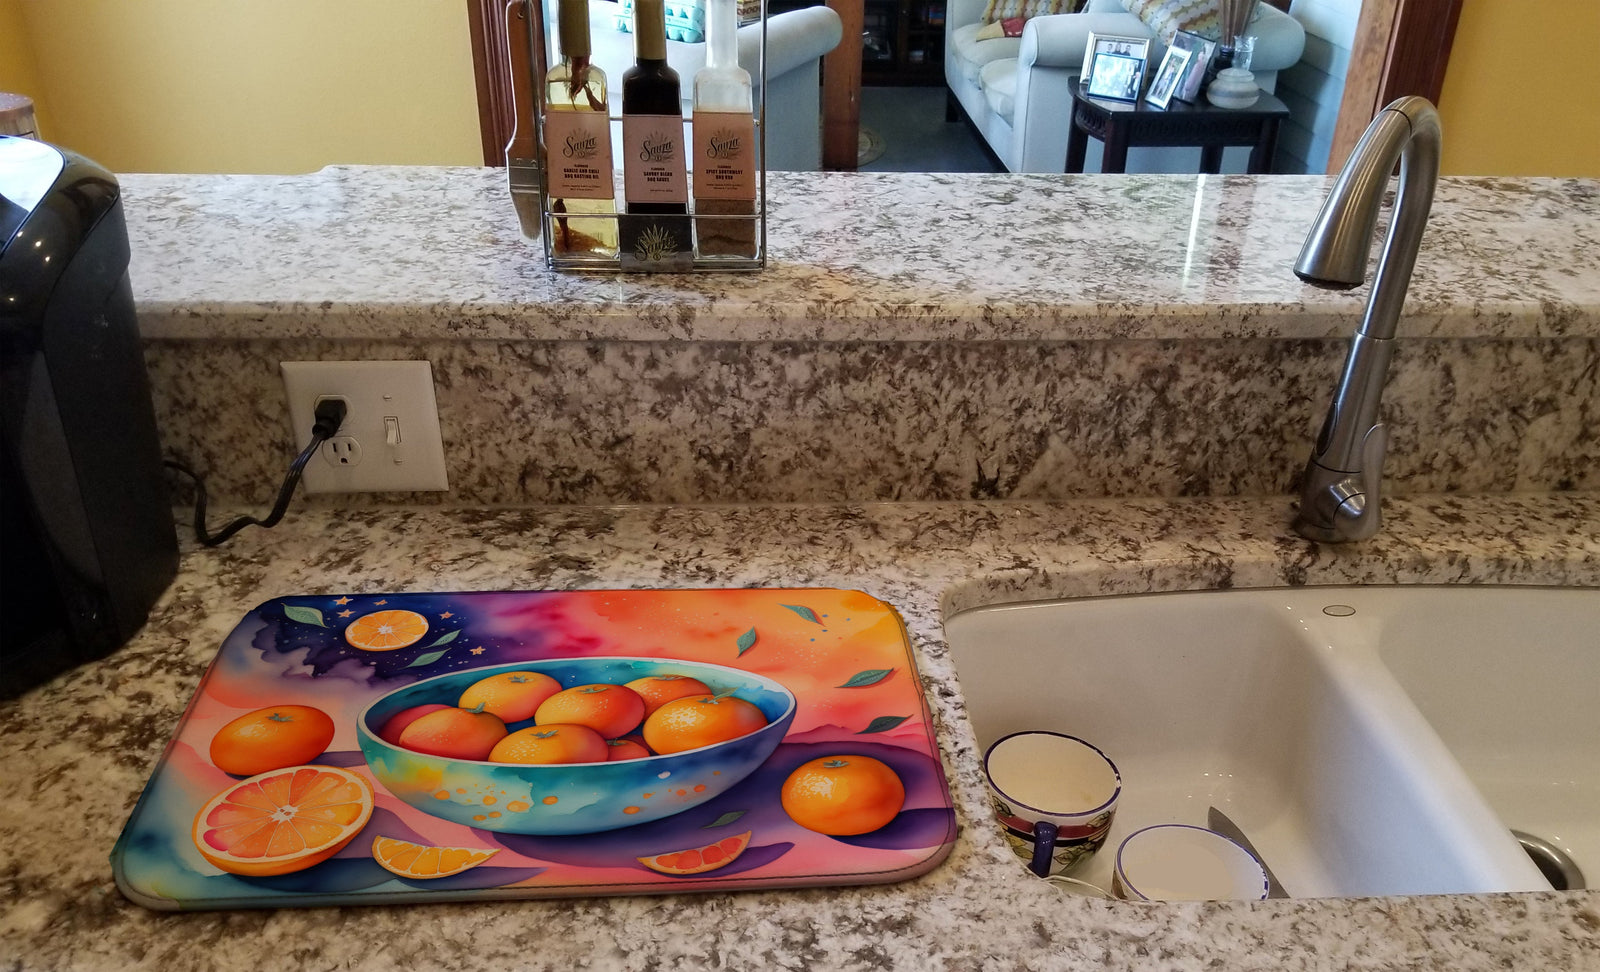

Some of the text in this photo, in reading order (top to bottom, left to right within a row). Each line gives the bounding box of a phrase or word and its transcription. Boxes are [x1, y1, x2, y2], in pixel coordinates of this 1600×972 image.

[563, 136, 598, 158] Sauza
[640, 140, 674, 162] Sauza
[707, 136, 740, 158] Sauza
